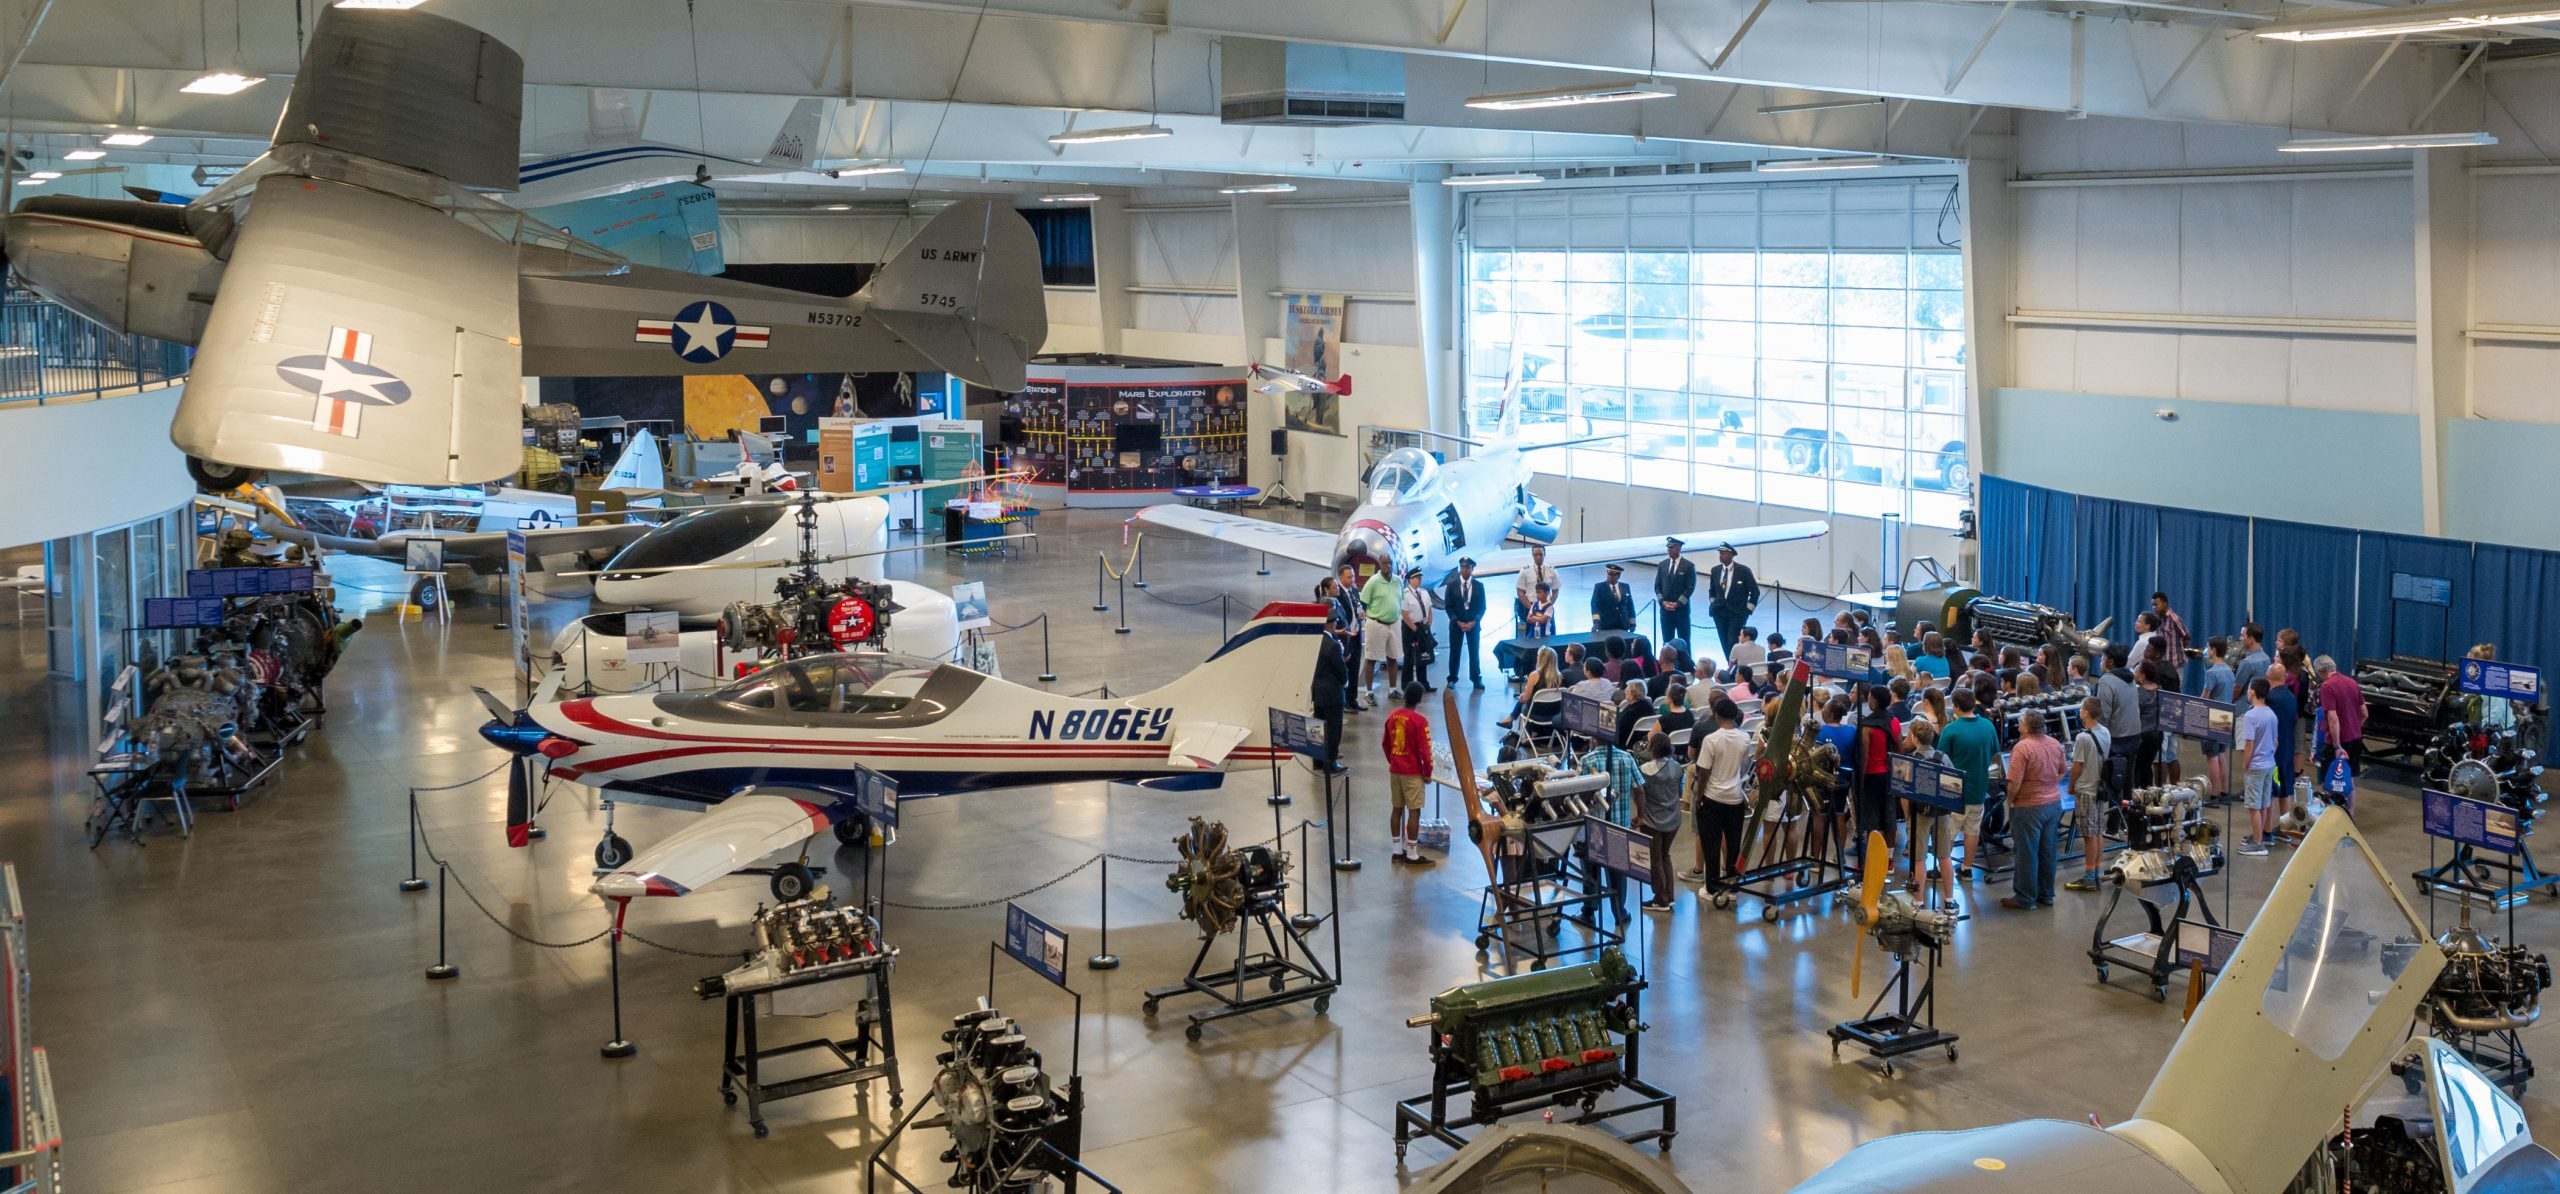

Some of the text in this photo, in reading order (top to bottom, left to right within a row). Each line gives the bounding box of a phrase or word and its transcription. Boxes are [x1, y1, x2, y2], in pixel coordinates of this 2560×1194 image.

[921, 248, 978, 263] US ARMY
[920, 293, 957, 308] 5745
[807, 312, 862, 327] N53792
[1028, 709, 1055, 740] N
